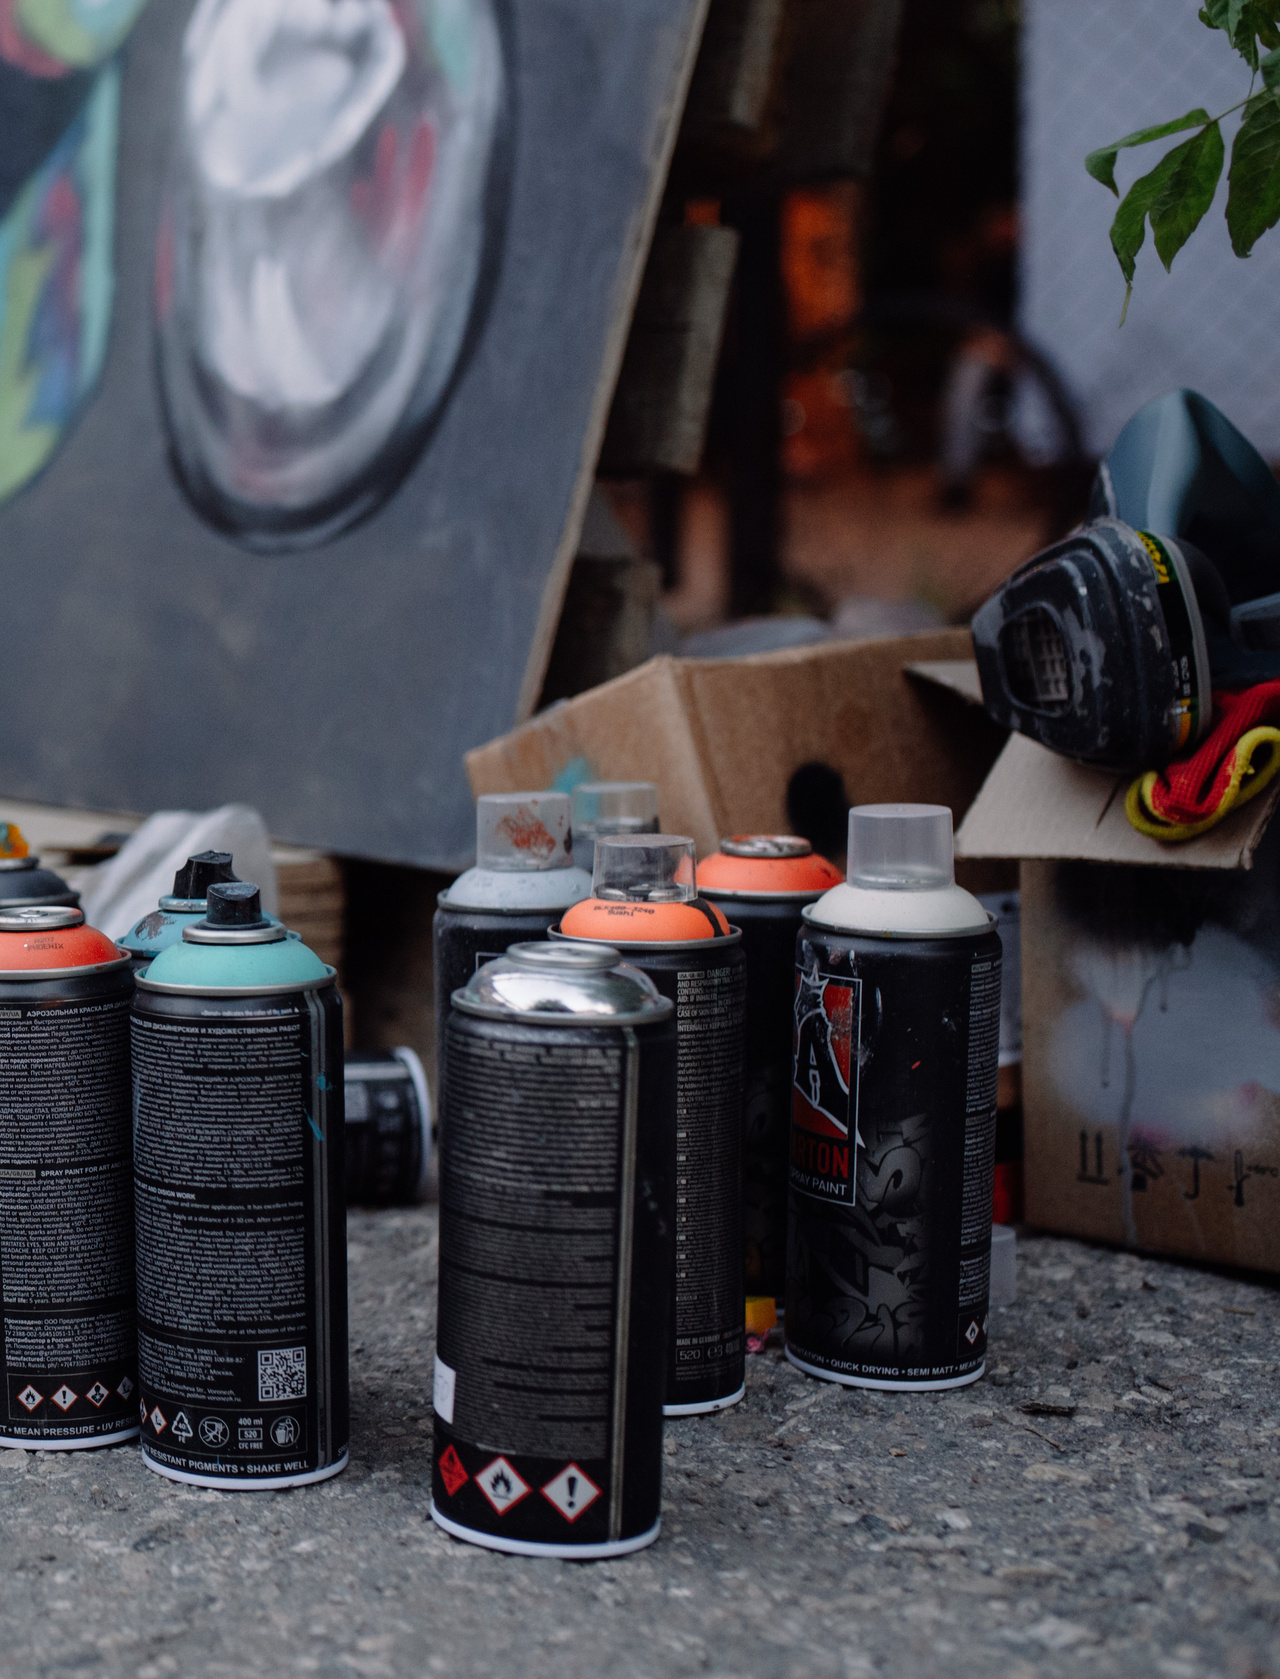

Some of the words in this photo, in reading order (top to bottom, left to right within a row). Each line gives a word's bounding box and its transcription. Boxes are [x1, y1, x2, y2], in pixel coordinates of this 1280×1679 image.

[812, 1177, 847, 1196] PAINT
[176, 1191, 196, 1200] WORK
[676, 1338, 691, 1346] MADE
[699, 1334, 720, 1343] GERMANY
[680, 1350, 700, 1360] 520
[830, 1358, 859, 1372] QUICK
[862, 1365, 899, 1376] DRYING
[907, 1368, 930, 1376] SEMI
[932, 1367, 953, 1375] MATT
[14, 1427, 41, 1436] MEAN
[44, 1425, 94, 1436] PRESSURE
[102, 1421, 113, 1431] UV
[150, 1447, 187, 1466] RESISTANT
[189, 1460, 238, 1473] PIGMENTS
[247, 1463, 282, 1473] SHAKE
[285, 1460, 309, 1470] WELL
